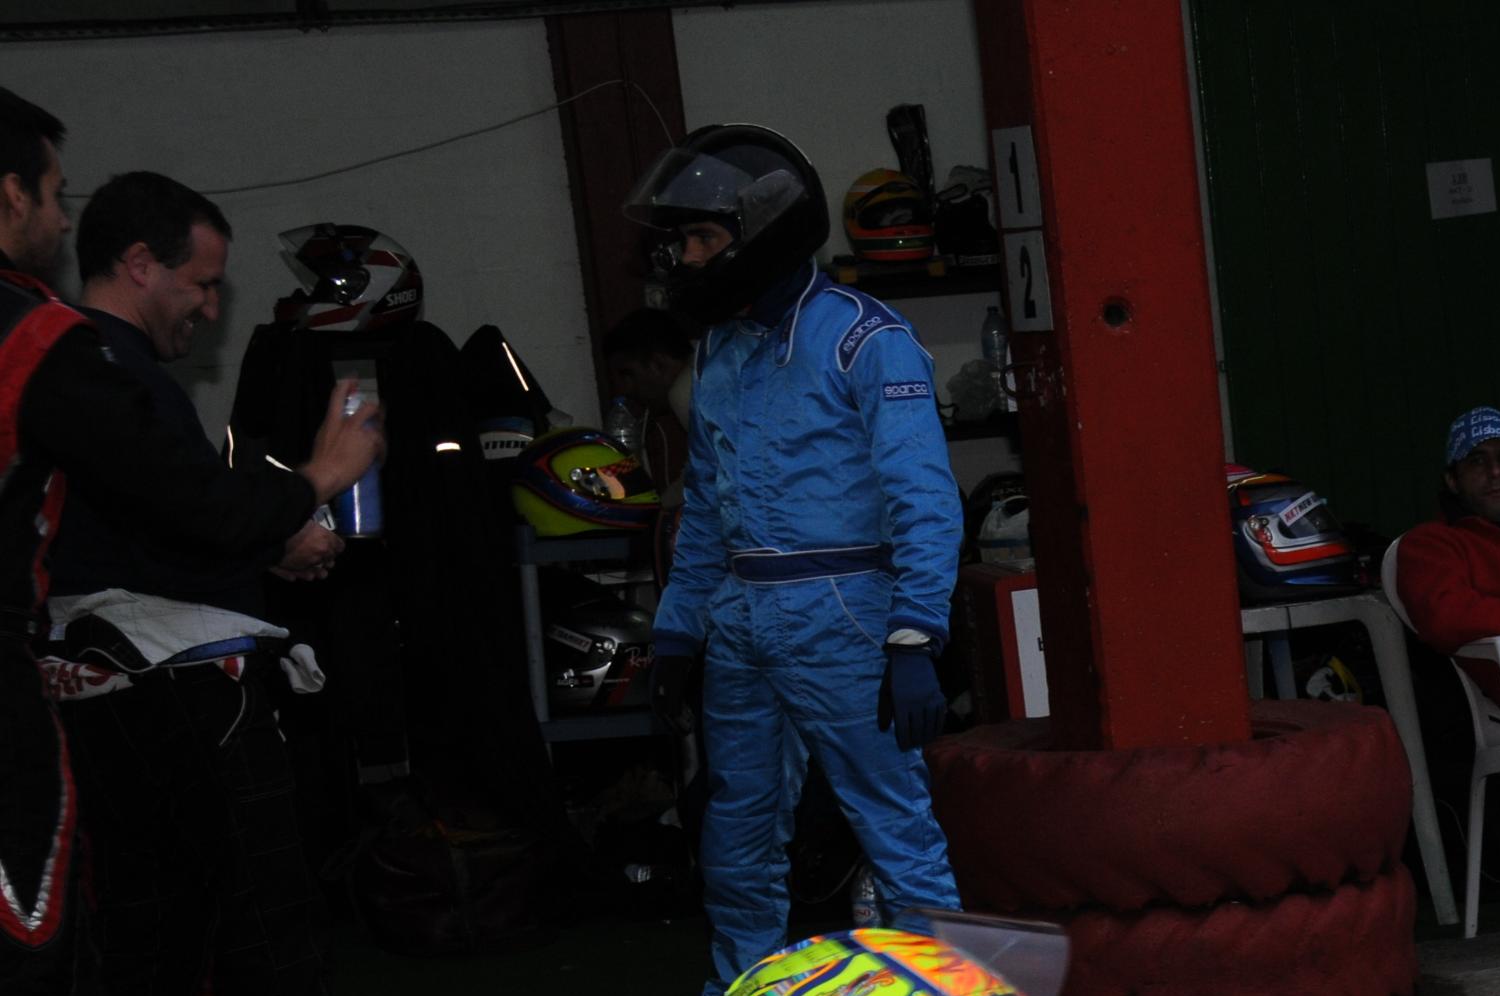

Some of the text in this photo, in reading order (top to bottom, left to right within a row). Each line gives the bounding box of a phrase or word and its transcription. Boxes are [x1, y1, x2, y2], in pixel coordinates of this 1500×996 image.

[1009, 142, 1024, 213] 1
[1020, 246, 1037, 318] 2
[843, 316, 881, 352] sparco
[884, 383, 928, 397] sparco
